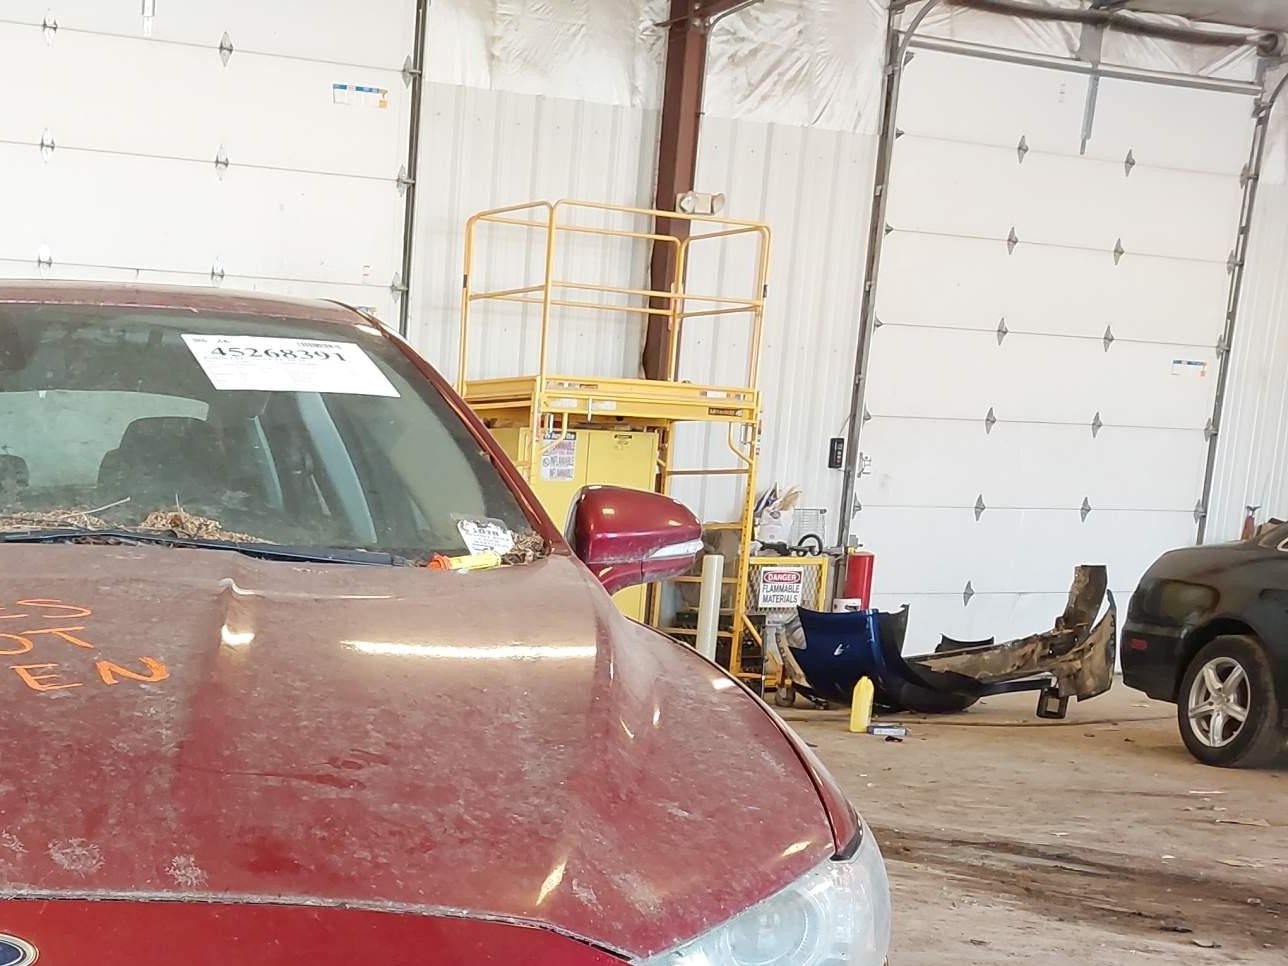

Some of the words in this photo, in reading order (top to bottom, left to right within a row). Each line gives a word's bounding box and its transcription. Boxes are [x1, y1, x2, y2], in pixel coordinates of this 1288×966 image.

[210, 346, 347, 362] 45268391
[767, 573, 797, 582] DANGER
[762, 584, 800, 593] FLAMMABLE
[762, 594, 798, 604] MATERIALS
